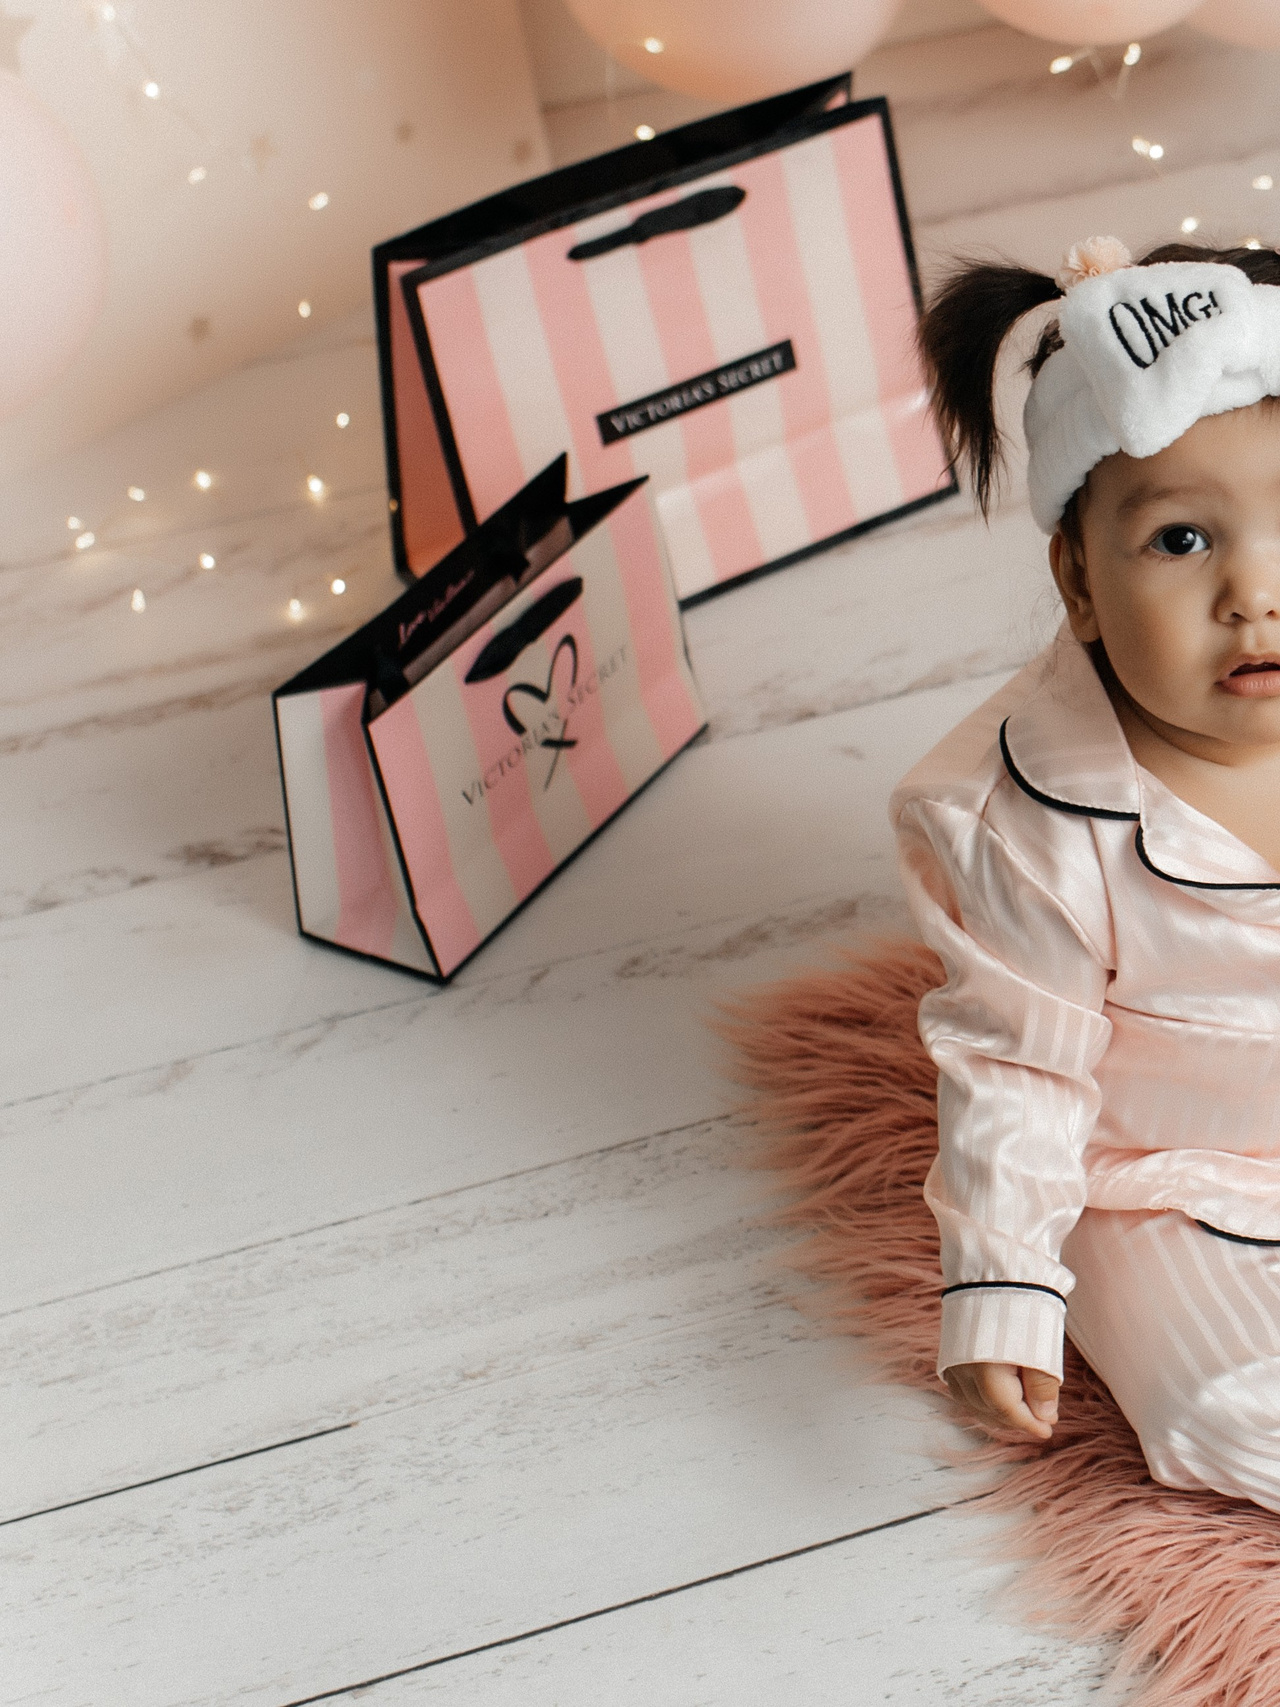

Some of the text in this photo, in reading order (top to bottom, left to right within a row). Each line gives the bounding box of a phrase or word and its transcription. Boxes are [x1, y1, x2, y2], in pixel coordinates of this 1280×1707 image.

[1108, 290, 1223, 370] OMG!
[716, 350, 785, 393] SECRET
[566, 648, 628, 713] SECRET
